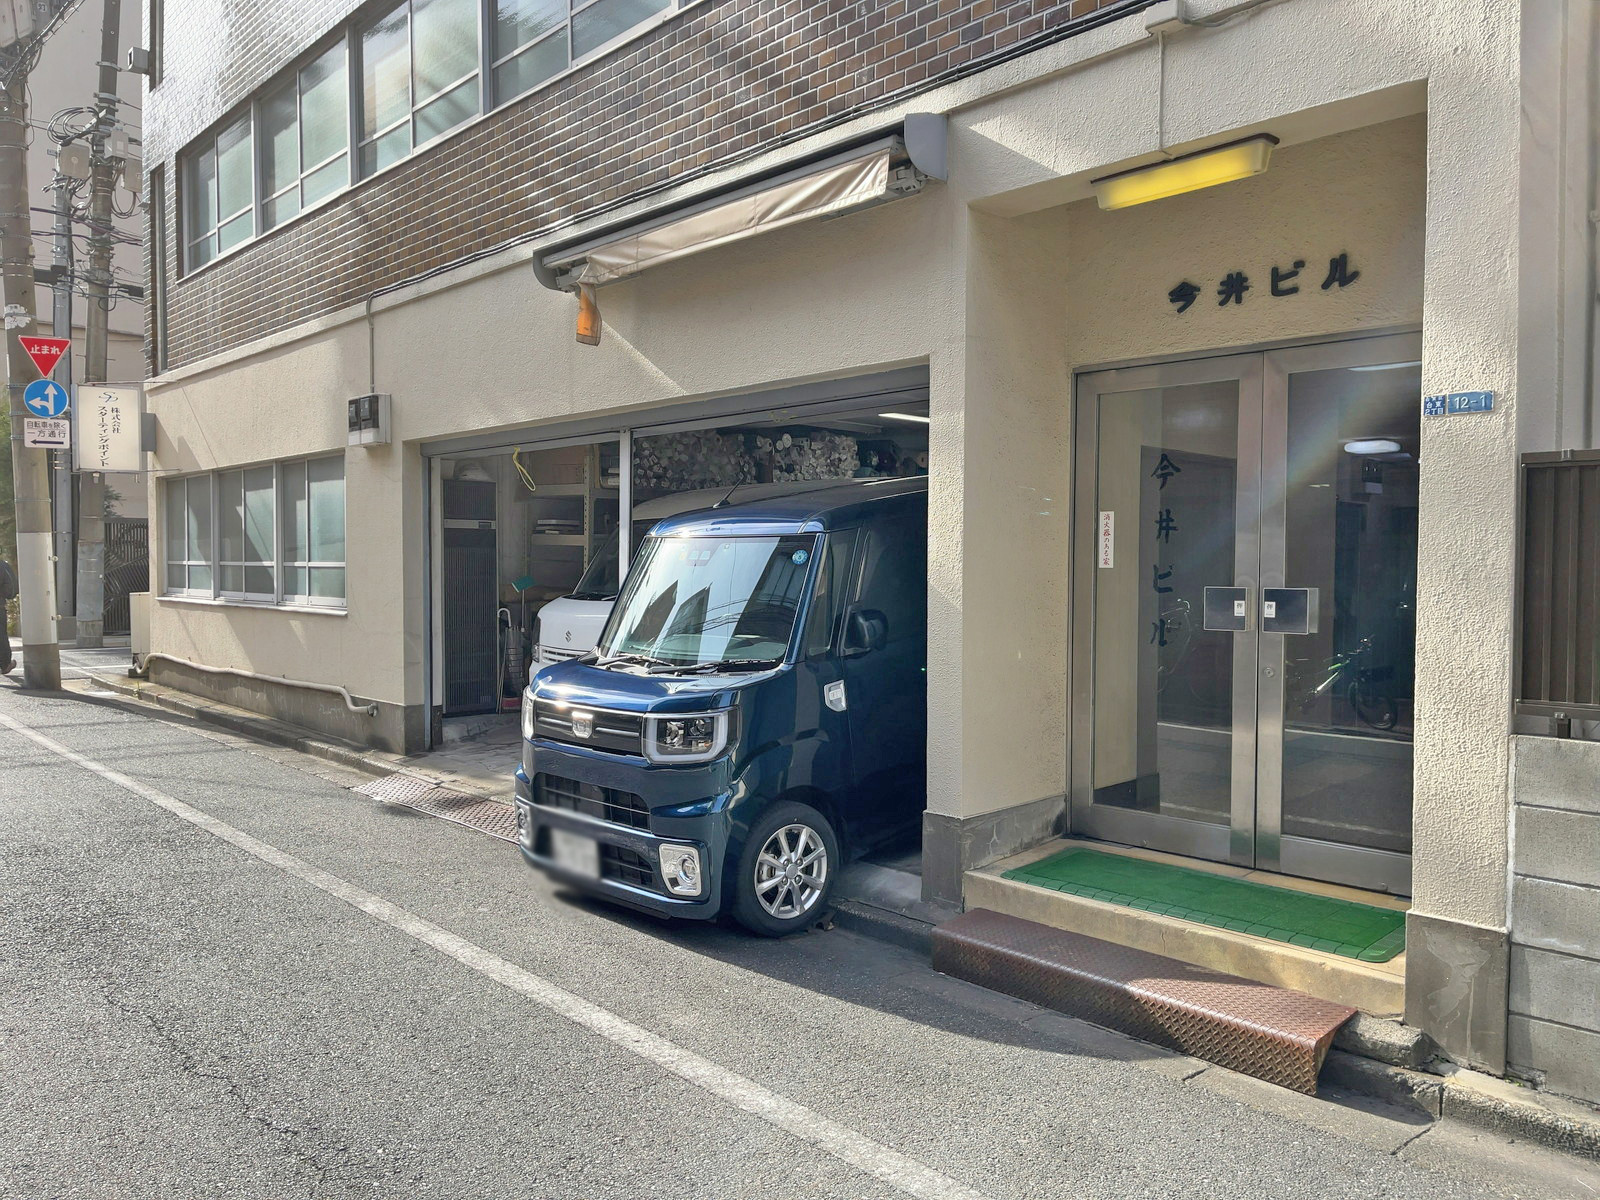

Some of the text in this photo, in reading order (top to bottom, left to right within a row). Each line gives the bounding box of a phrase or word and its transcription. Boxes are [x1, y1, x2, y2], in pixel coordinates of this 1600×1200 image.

[1168, 253, 1361, 314] 今井ビル
[30, 344, 61, 355] 止まれ
[1454, 395, 1486, 410] 12-1
[26, 420, 66, 430] 自転車を除く
[27, 430, 67, 438] 一方通行
[111, 407, 121, 434] 株式会社
[98, 406, 110, 467] スターティングポイント
[1103, 513, 1111, 566] 消火器のある家
[1150, 453, 1182, 646] 今井ビル
